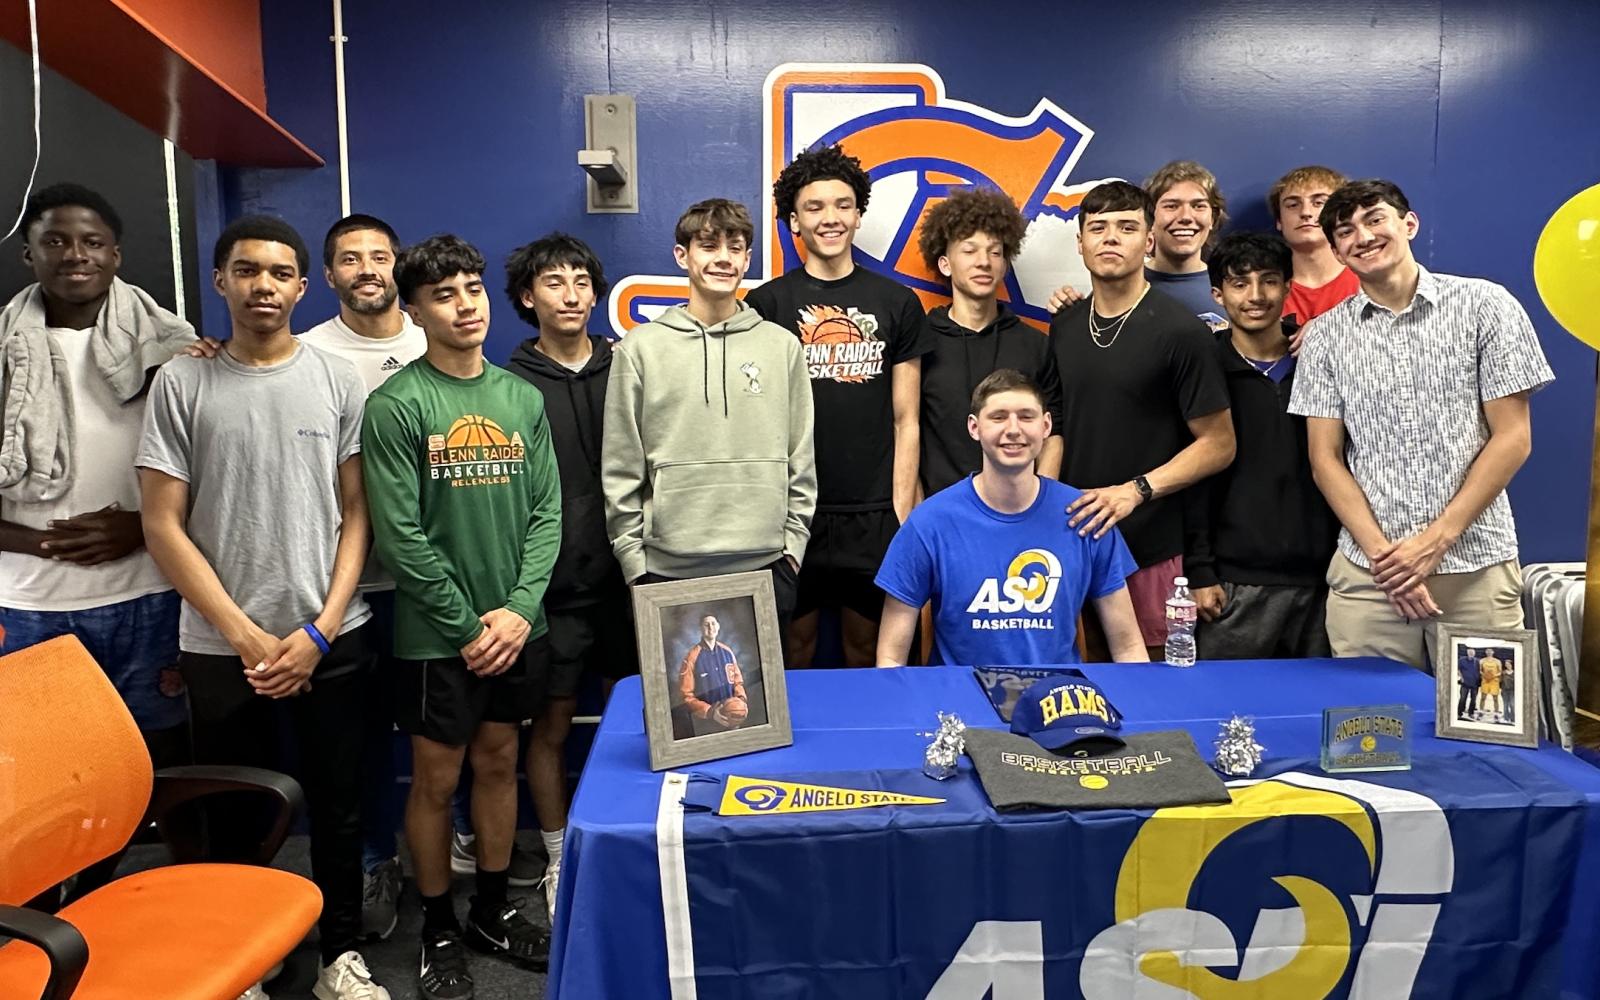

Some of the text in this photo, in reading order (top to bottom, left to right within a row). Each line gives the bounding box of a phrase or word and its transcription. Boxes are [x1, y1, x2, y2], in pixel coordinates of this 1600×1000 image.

[803, 340, 886, 364] ENN RAIDER
[808, 361, 884, 379] SKETBALL
[428, 431, 524, 451] S A
[429, 446, 525, 464] GLENN RAIDER
[430, 463, 524, 480] BASKETBALL
[972, 618, 1055, 630] BASKETBALL
[1039, 688, 1109, 726] RAMS
[1334, 715, 1404, 744] ANGELO STATE
[1001, 750, 1171, 773] BASKETBALL
[790, 788, 855, 808] ANGELO
